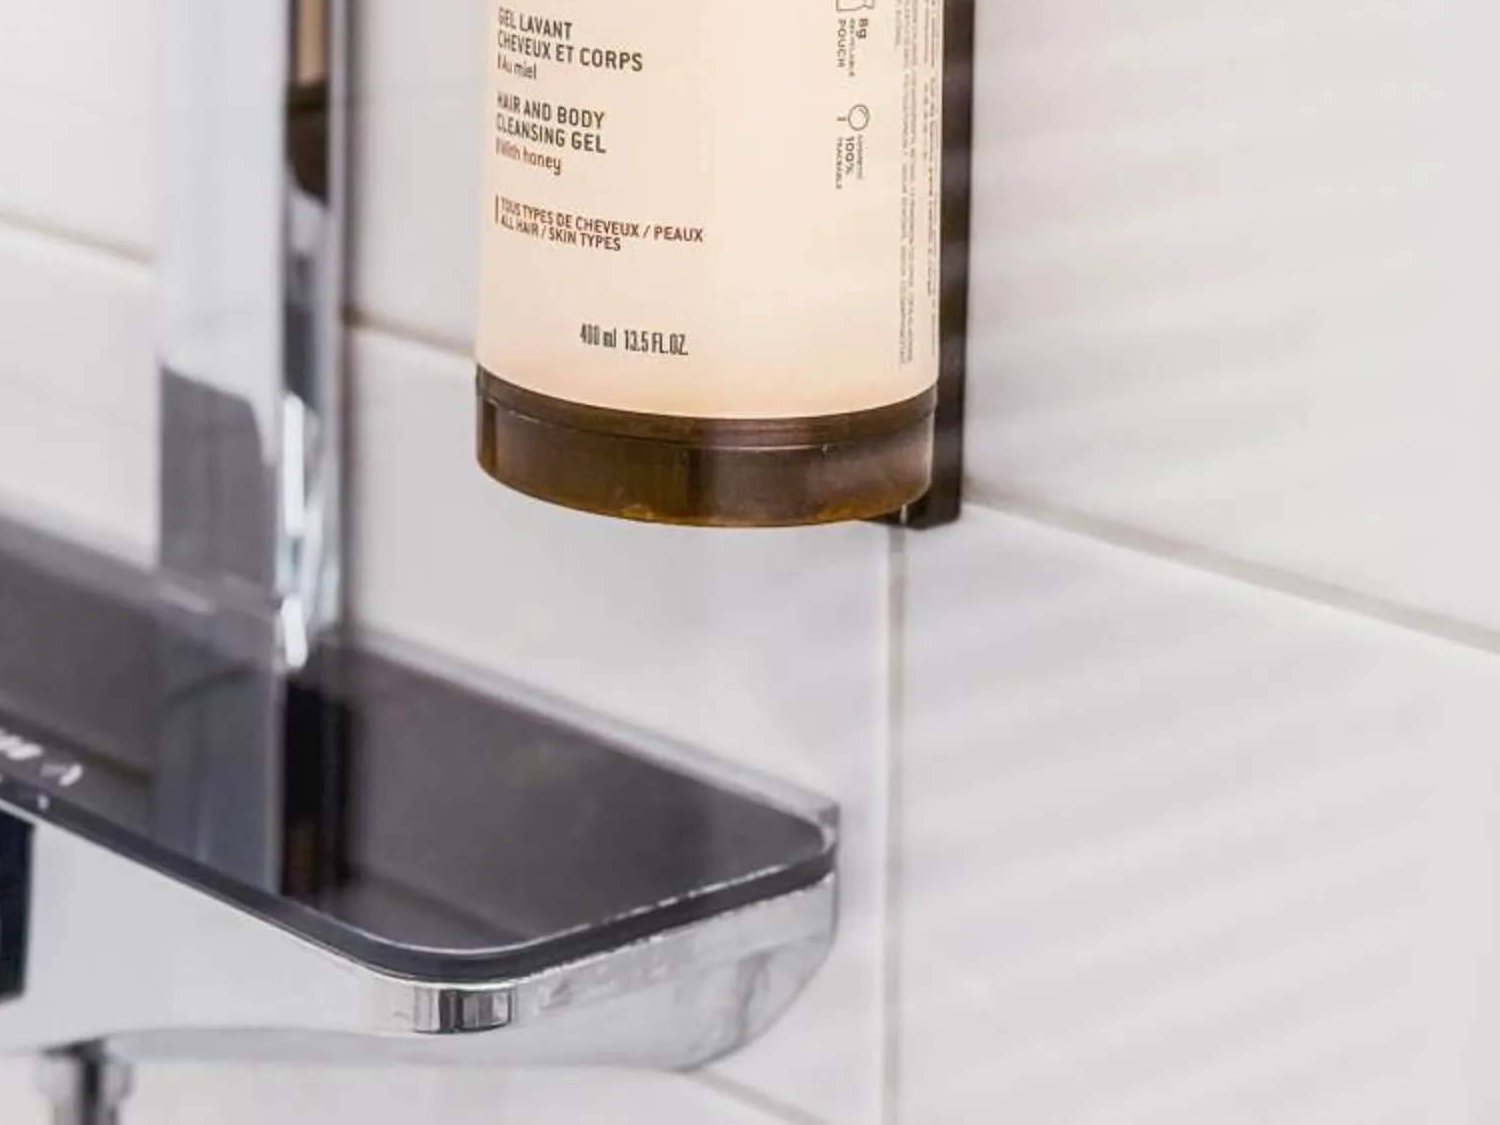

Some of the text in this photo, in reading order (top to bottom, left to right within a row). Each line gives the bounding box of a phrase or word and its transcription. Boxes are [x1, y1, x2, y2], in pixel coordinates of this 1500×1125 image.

[498, 6, 573, 41] GEL LAVANT
[836, 18, 847, 68] POUCH
[498, 29, 643, 72] CHEVEUX ET CORPS
[514, 60, 537, 80] miel
[496, 90, 605, 130] HAIR AND BODY
[496, 112, 607, 154] CLEANSING GEL
[523, 146, 562, 176] honey
[501, 196, 520, 216] TOUS
[523, 204, 553, 226] TYPES
[555, 212, 573, 230] DE
[575, 215, 639, 239] CHEVEUX
[653, 226, 704, 244] PEAUX
[501, 214, 514, 231] ALL
[515, 220, 539, 238] HAIR
[548, 226, 577, 246] SKIN
[580, 233, 622, 252] TYPES
[579, 323, 600, 346] 400
[602, 327, 617, 348] ml
[624, 329, 649, 353] 13.5
